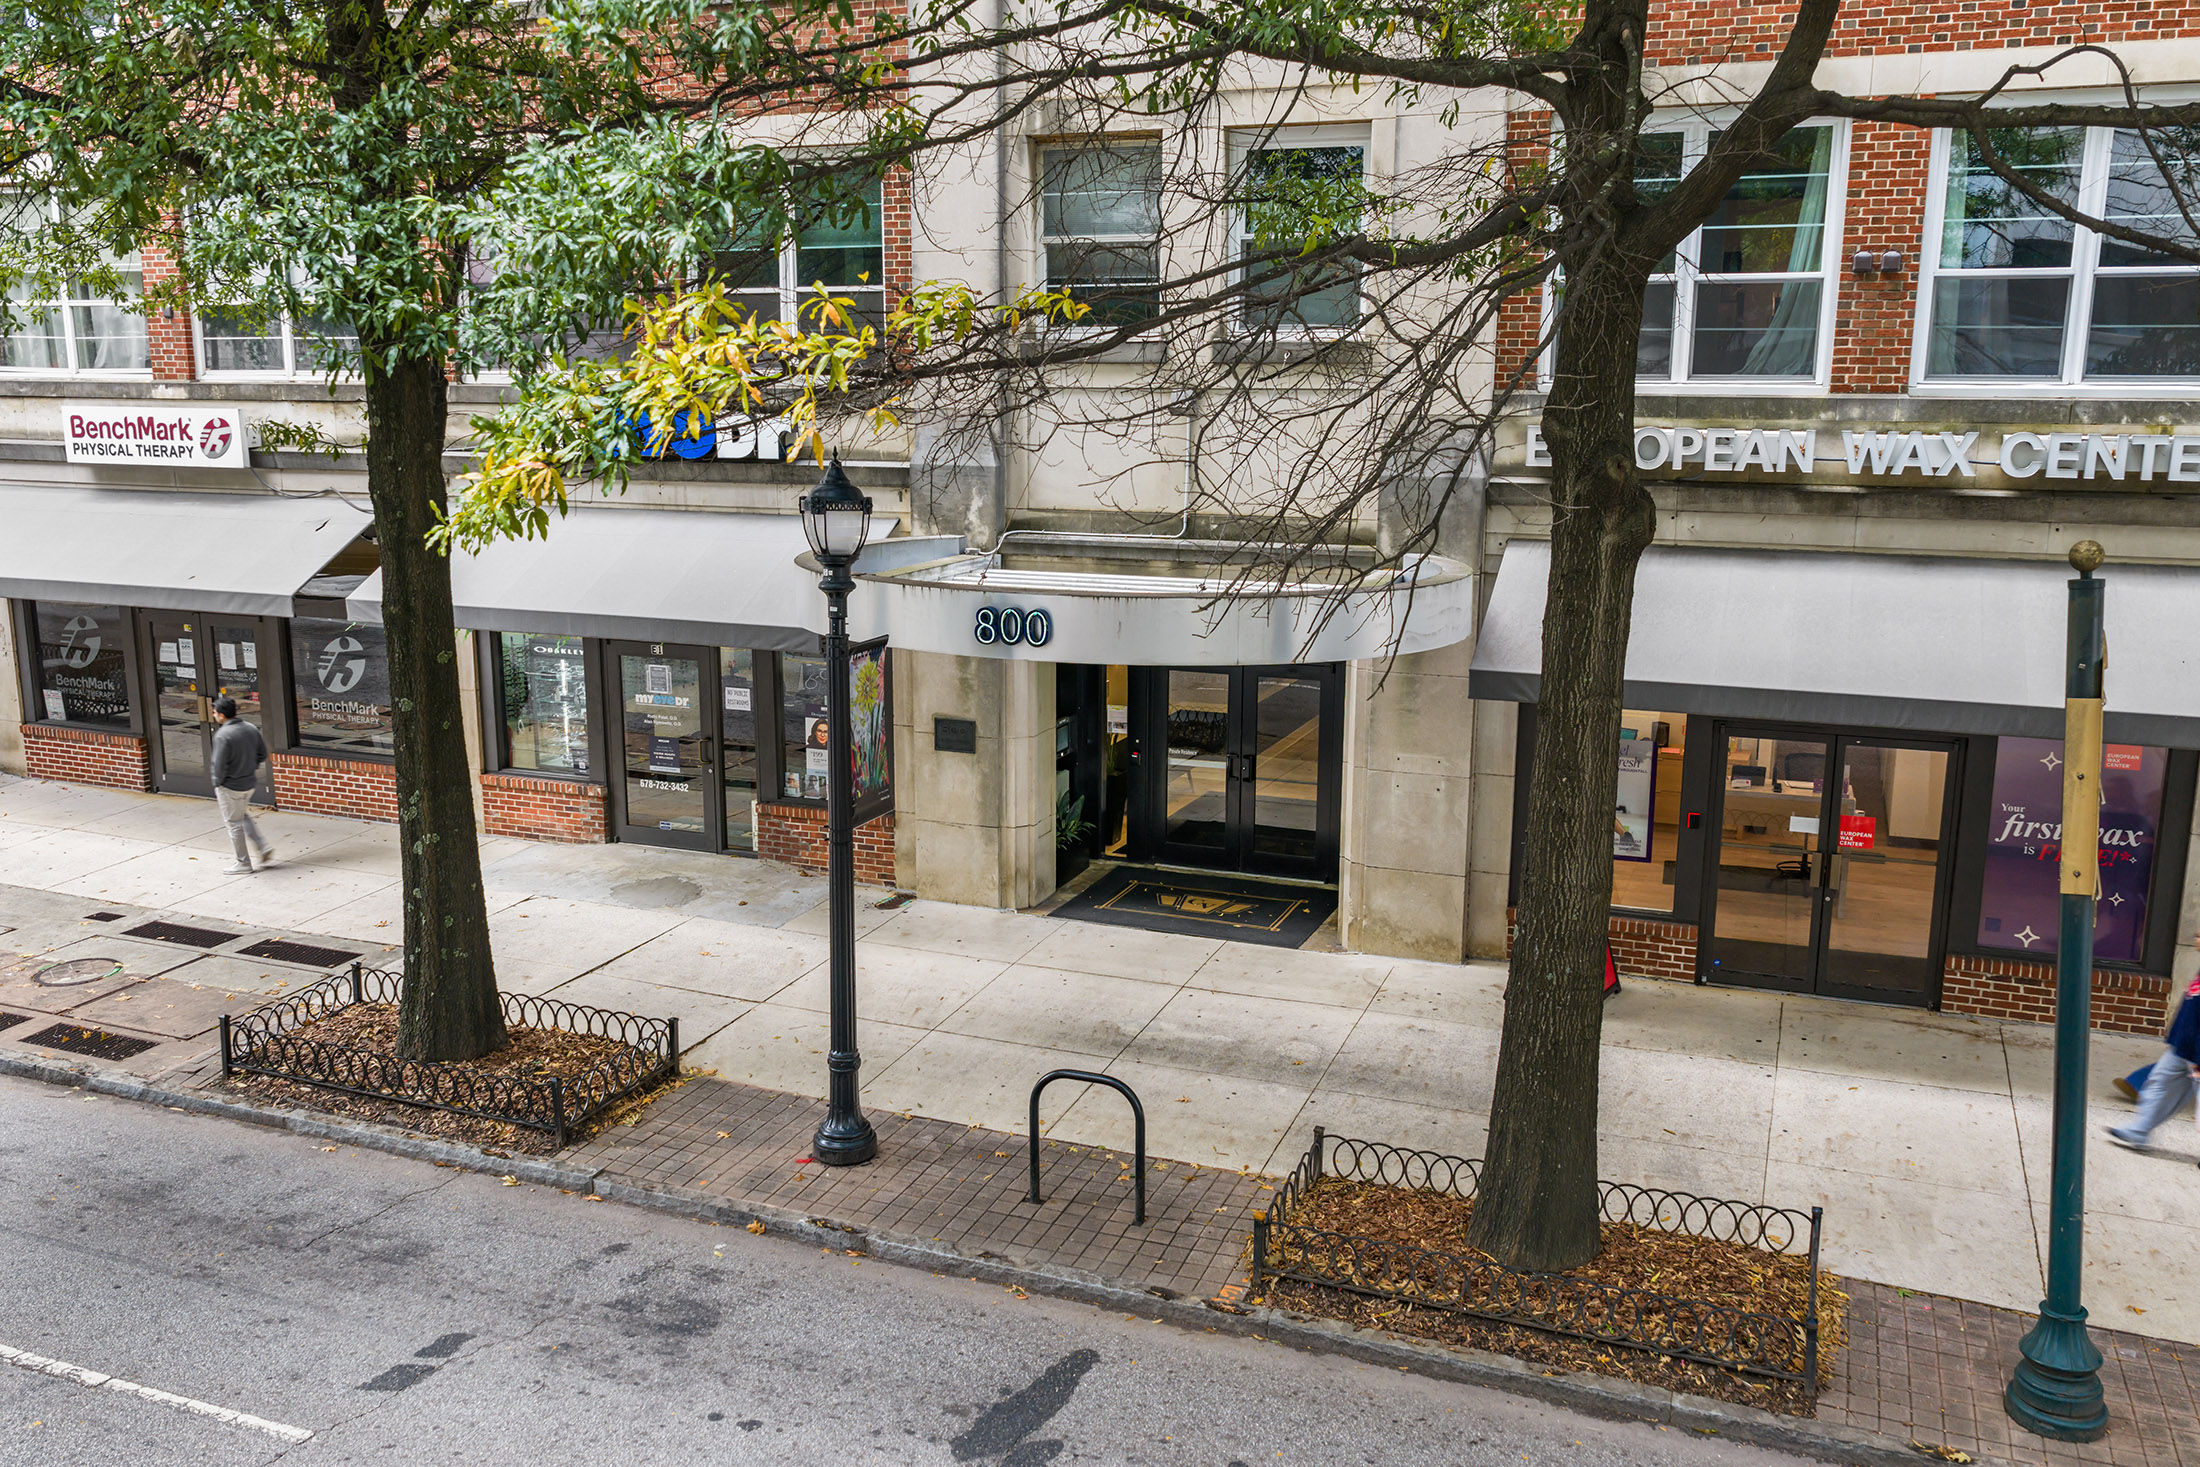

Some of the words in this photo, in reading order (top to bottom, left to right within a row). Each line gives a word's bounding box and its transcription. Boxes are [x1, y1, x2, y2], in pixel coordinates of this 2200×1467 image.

[70, 415, 193, 441] BenchMark
[73, 442, 133, 457] PHYSICAL
[136, 444, 194, 459] THERAPY
[1526, 424, 1816, 473] EOPEAN
[1841, 430, 1979, 477] WAX
[974, 606, 1054, 647] 800
[55, 673, 115, 690] BenchMark
[87, 690, 116, 698] THERAPY
[311, 697, 380, 716] BenchMark
[312, 712, 346, 722] PHYSICAL
[347, 715, 380, 725] THERAPY
[2107, 753, 2140, 761] EUROPEAN
[640, 779, 689, 792] 678-732-3432
[2001, 803, 2026, 813] Your
[2023, 842, 2036, 855] is
